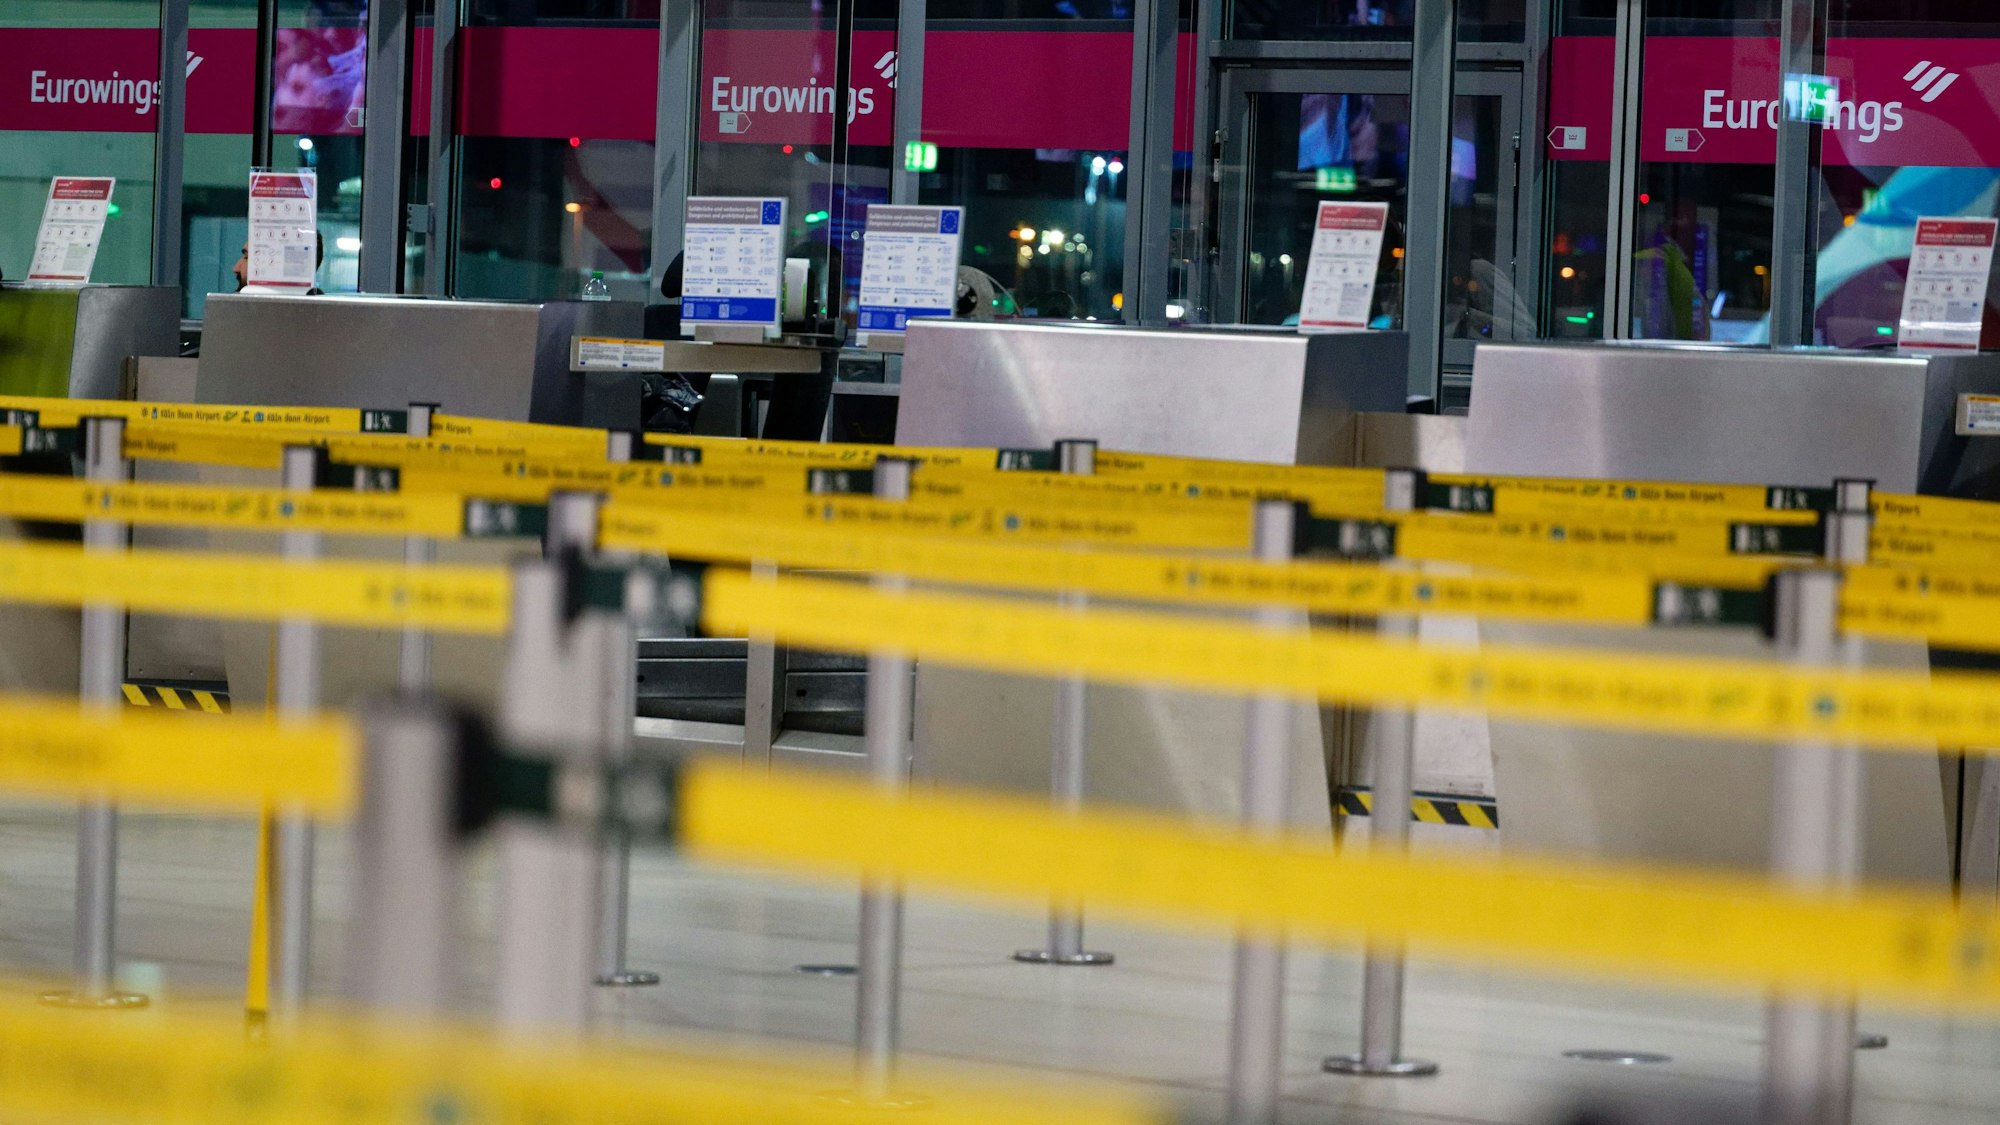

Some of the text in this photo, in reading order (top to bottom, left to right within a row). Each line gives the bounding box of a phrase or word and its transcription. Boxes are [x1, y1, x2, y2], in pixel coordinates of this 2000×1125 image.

[1703, 90, 1904, 142] Euroings
[195, 410, 220, 421] Airport
[304, 414, 330, 424] Airport
[446, 423, 471, 434] Airport
